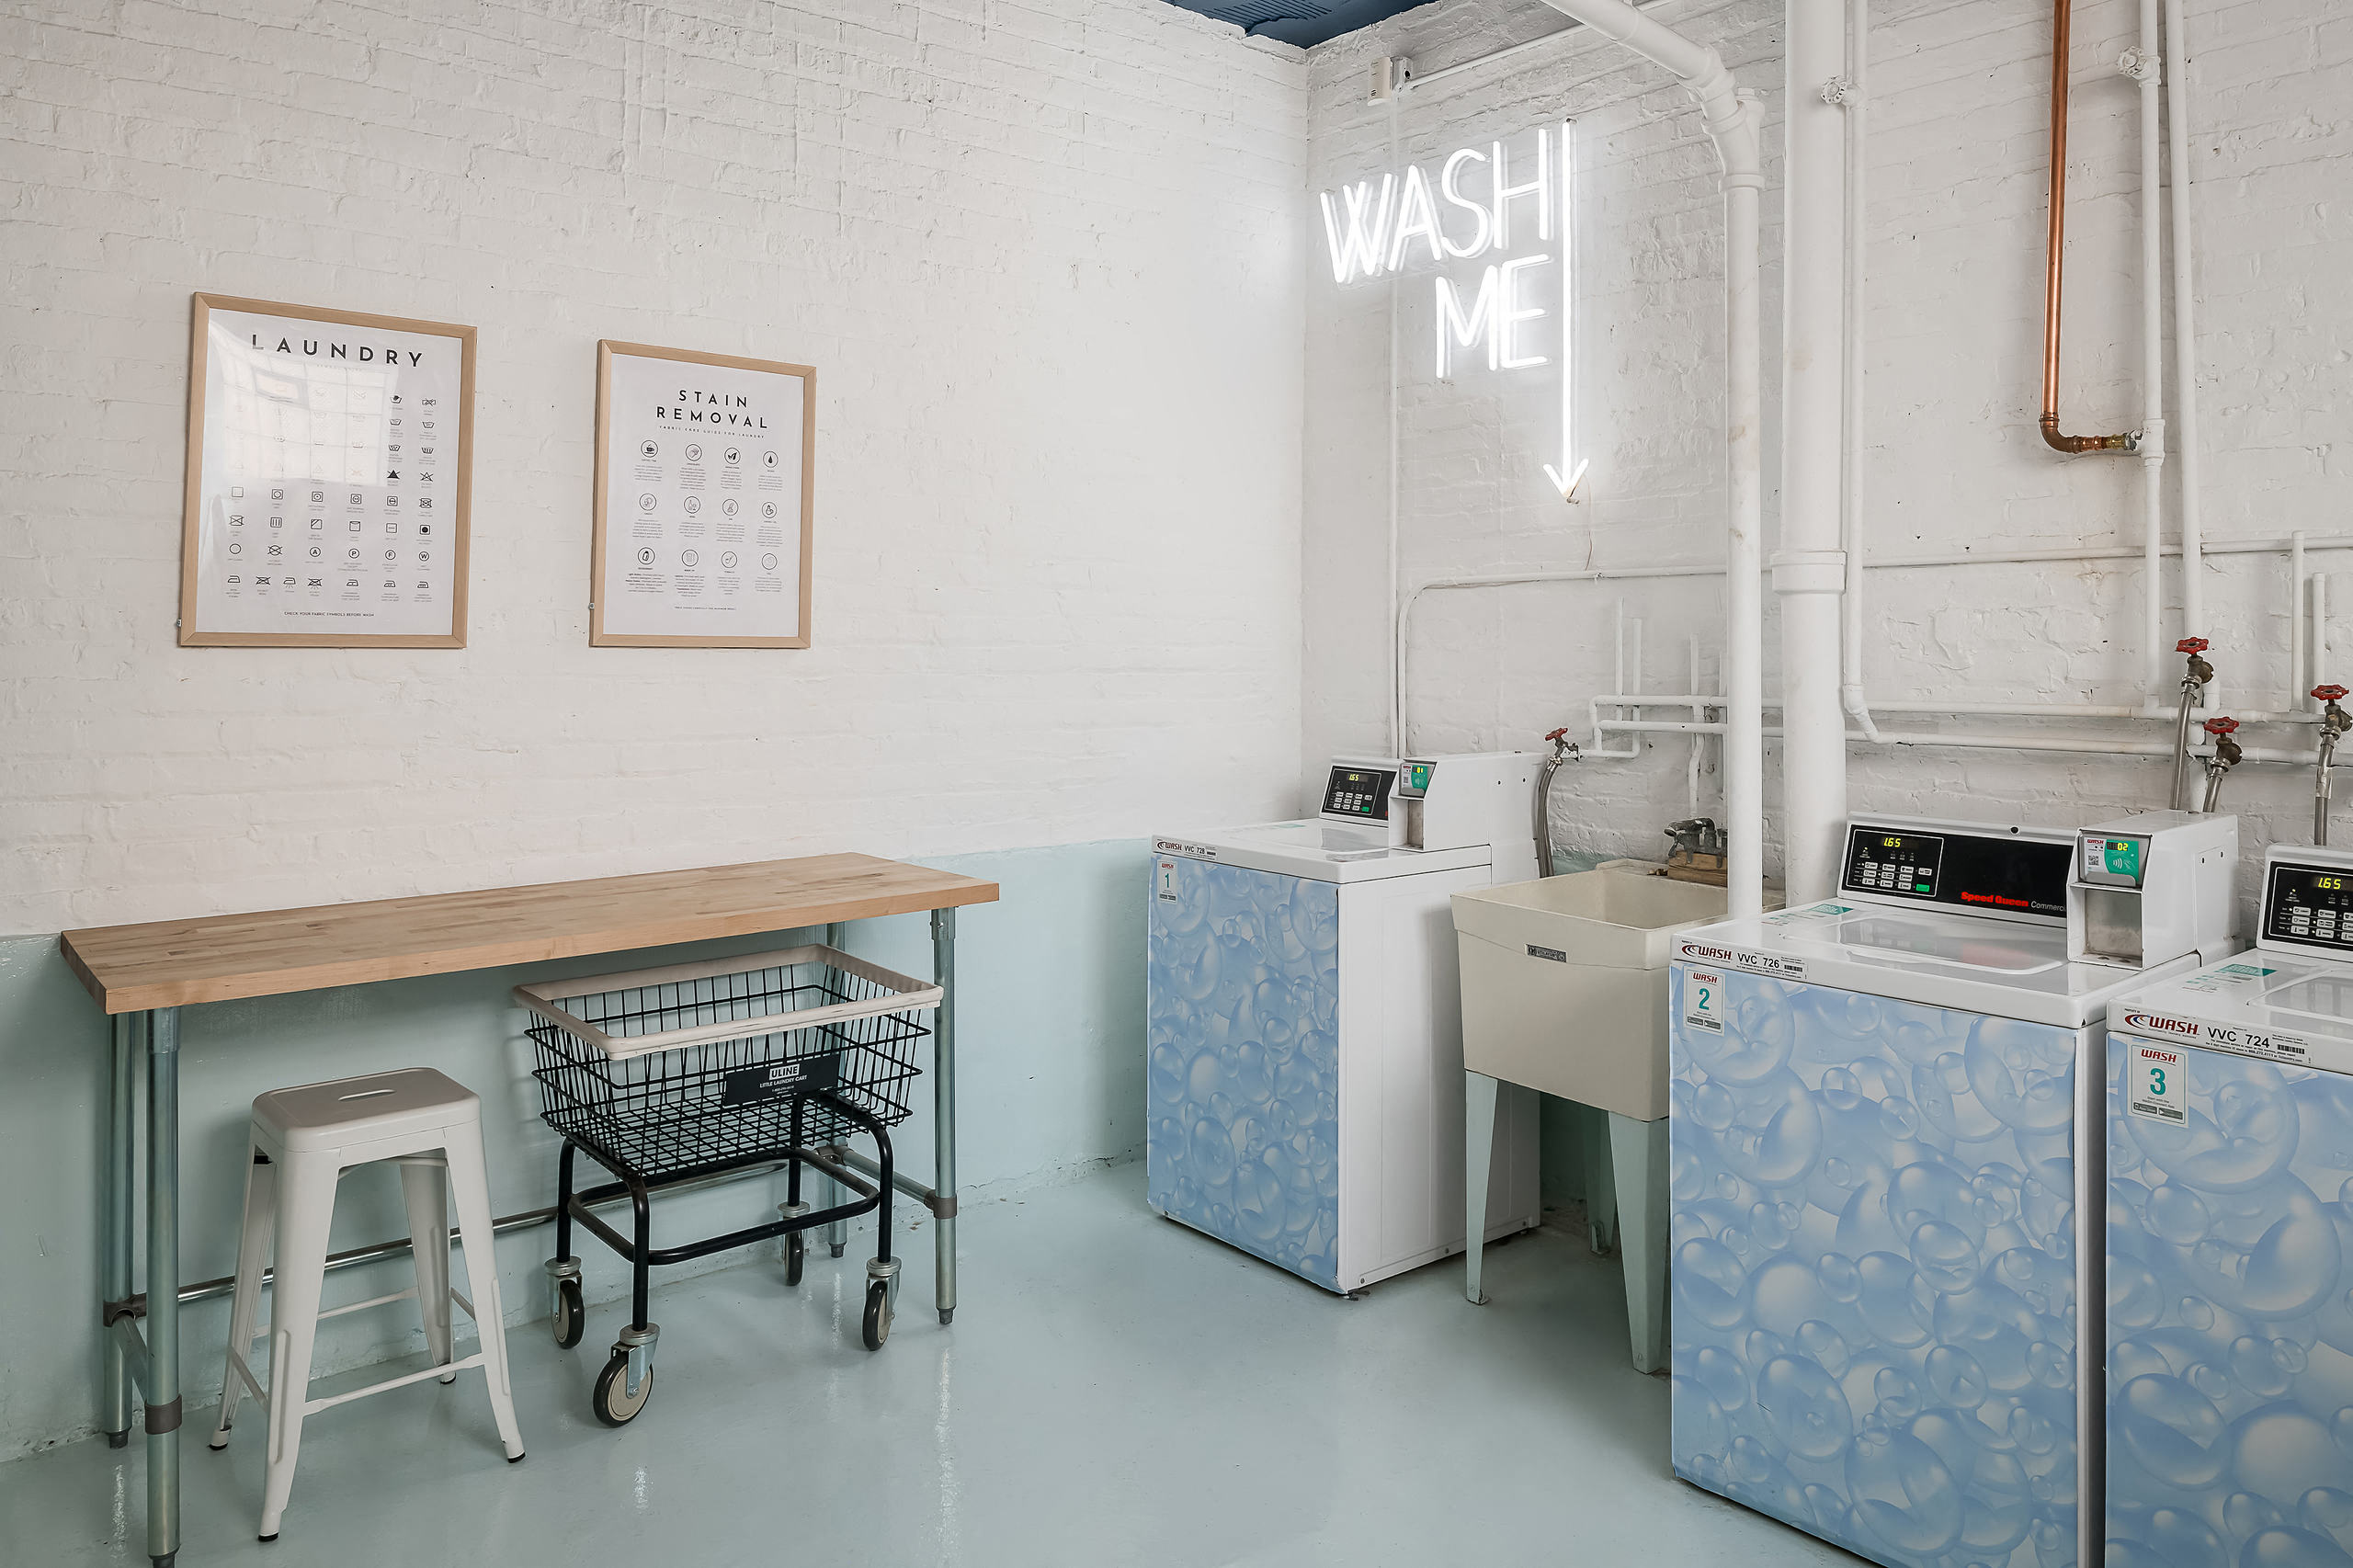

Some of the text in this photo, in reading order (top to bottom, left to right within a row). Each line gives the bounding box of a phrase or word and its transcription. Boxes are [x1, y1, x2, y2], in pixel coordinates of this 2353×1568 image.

[1319, 128, 1549, 283] WASH
[1435, 253, 1550, 379] ME
[252, 334, 423, 368] LAUNDRY
[678, 390, 747, 408] STAIN
[656, 405, 767, 429] REMOVAL
[1165, 873, 1170, 889] 1
[1961, 891, 2066, 912] Speed Queen Commerci
[1698, 946, 1733, 960] WASH
[1737, 952, 1757, 965] VVC
[1763, 957, 1779, 969] 726
[1692, 972, 1718, 983] WASH
[1699, 987, 1711, 1011] 2
[2149, 1016, 2199, 1035] WASH
[2207, 1027, 2237, 1042] VVC
[2245, 1034, 2270, 1049] 724
[2141, 1049, 2177, 1063] WASH
[771, 1065, 798, 1078] ULINE
[2149, 1067, 2166, 1096] 3
